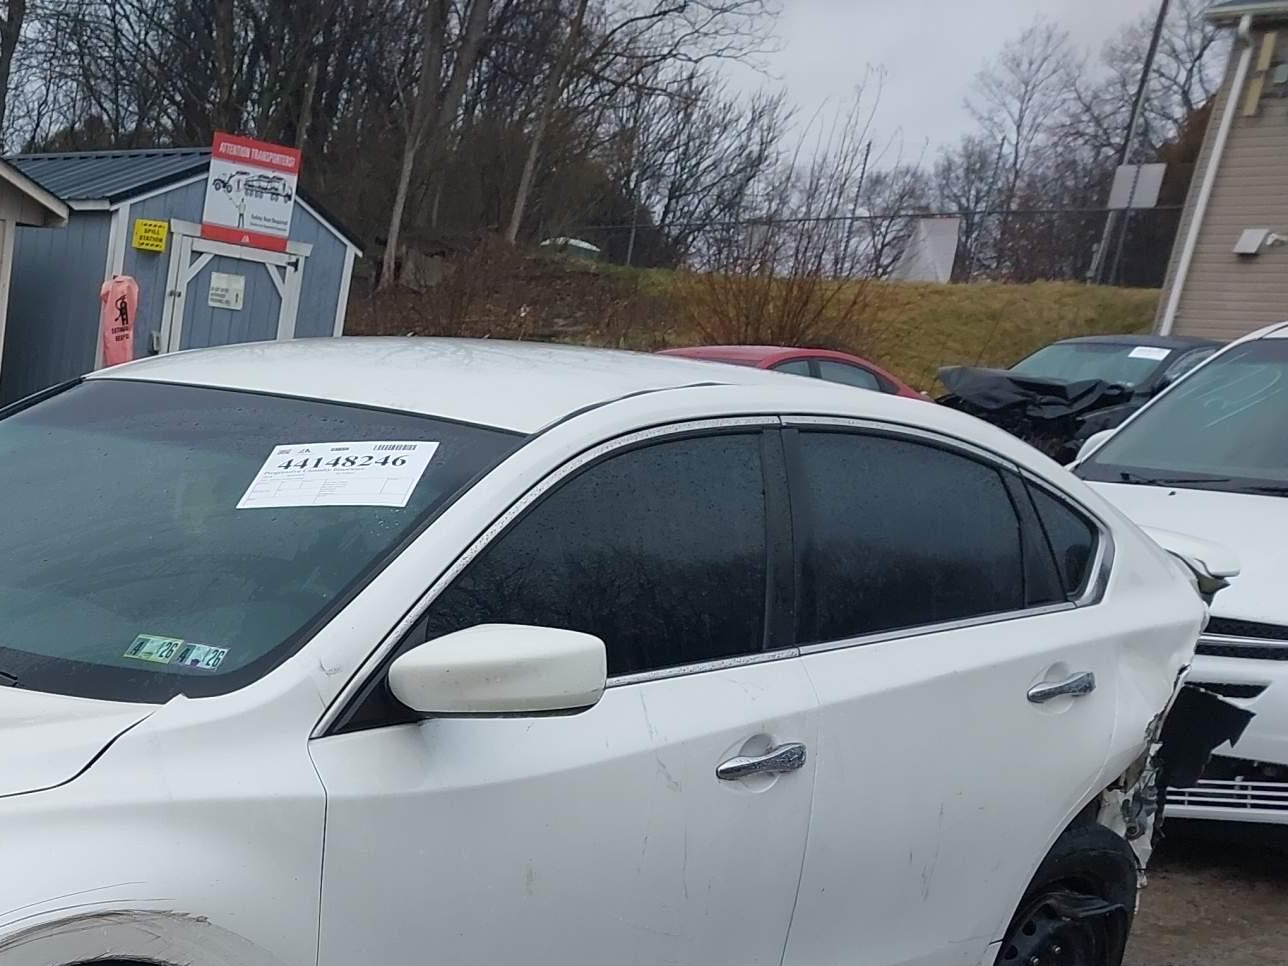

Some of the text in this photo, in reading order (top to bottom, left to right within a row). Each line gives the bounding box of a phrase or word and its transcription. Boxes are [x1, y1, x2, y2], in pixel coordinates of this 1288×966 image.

[143, 228, 160, 236] SPILL
[139, 235, 163, 243] STATION
[278, 454, 409, 470] 44148246
